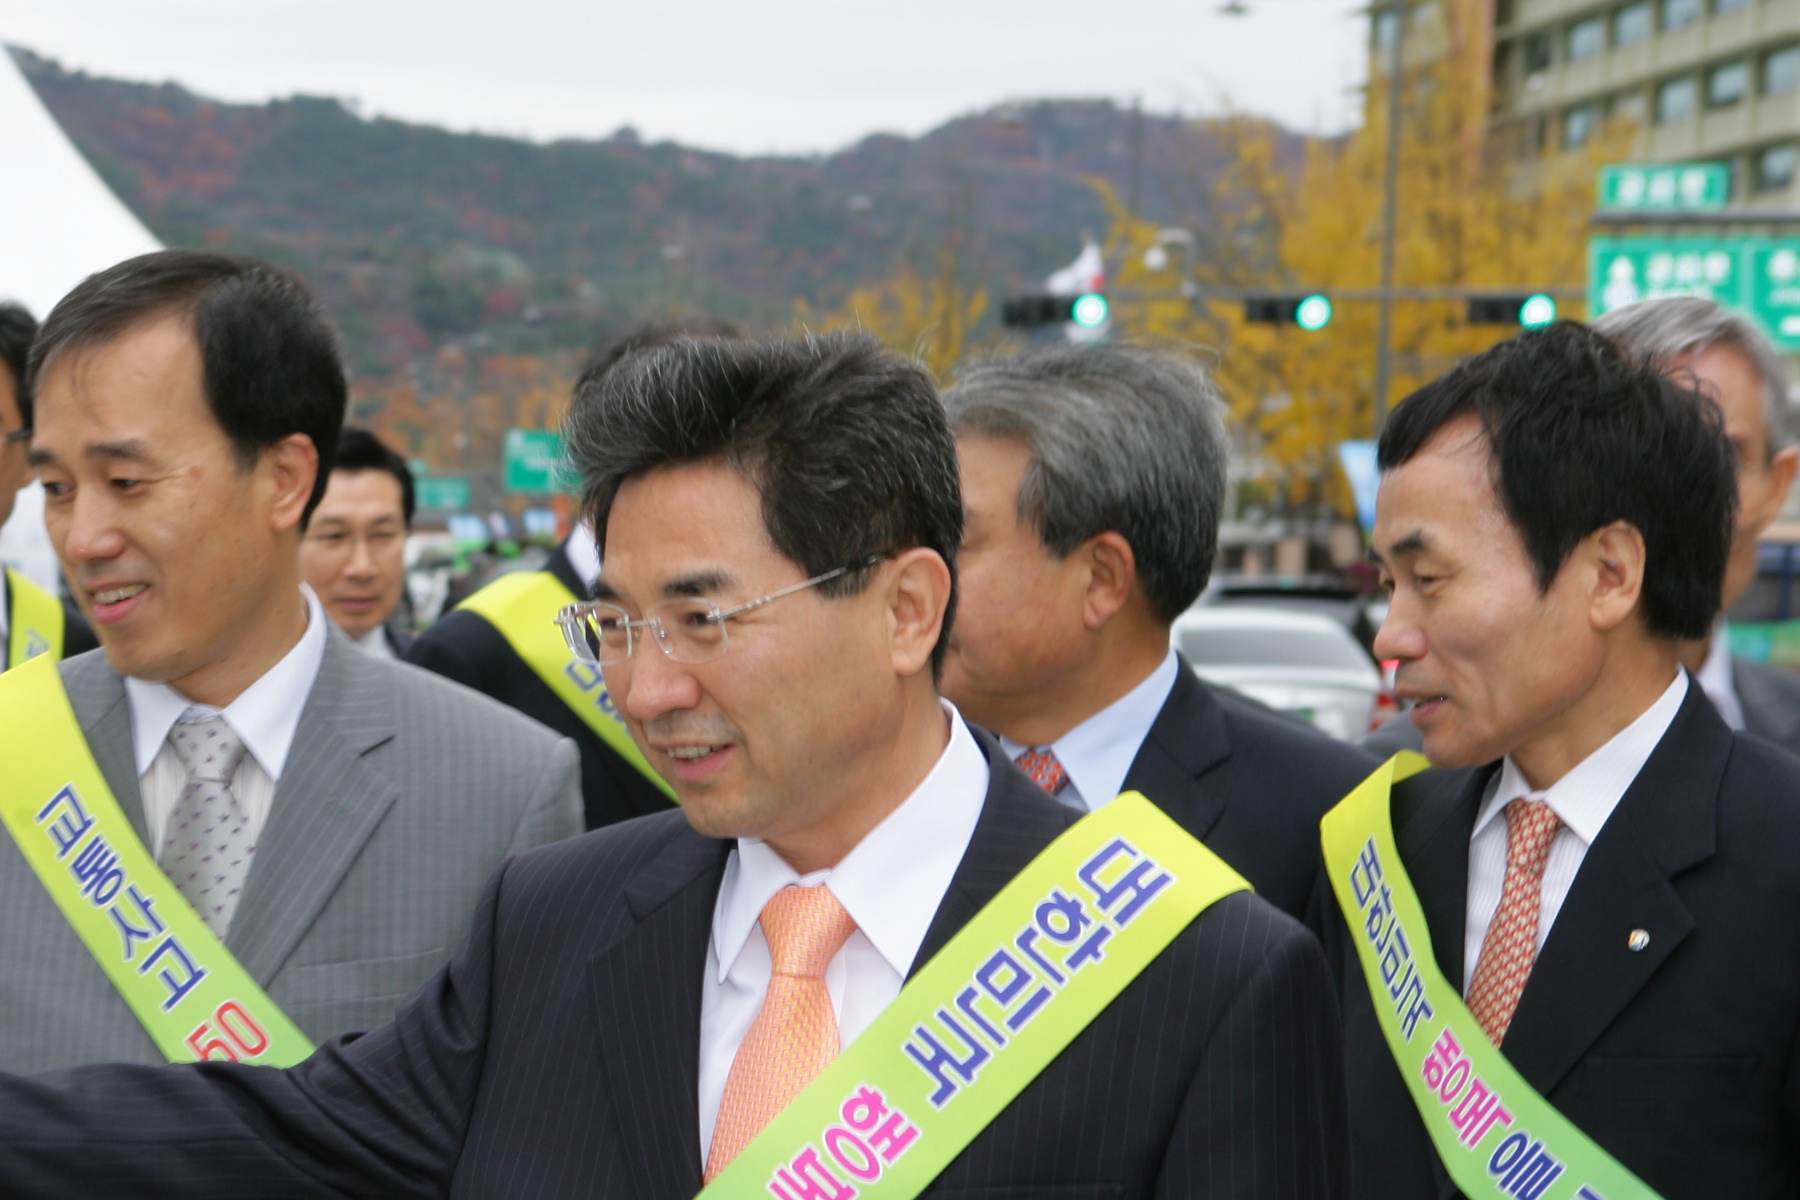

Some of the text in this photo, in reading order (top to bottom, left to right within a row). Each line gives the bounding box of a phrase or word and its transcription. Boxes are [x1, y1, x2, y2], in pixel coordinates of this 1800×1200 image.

[37, 785, 208, 1012] 교통사고
[903, 837, 1174, 1107] 대한민국
[1350, 836, 1436, 1042] 대한민국
[1421, 1026, 1515, 1149] 행복
